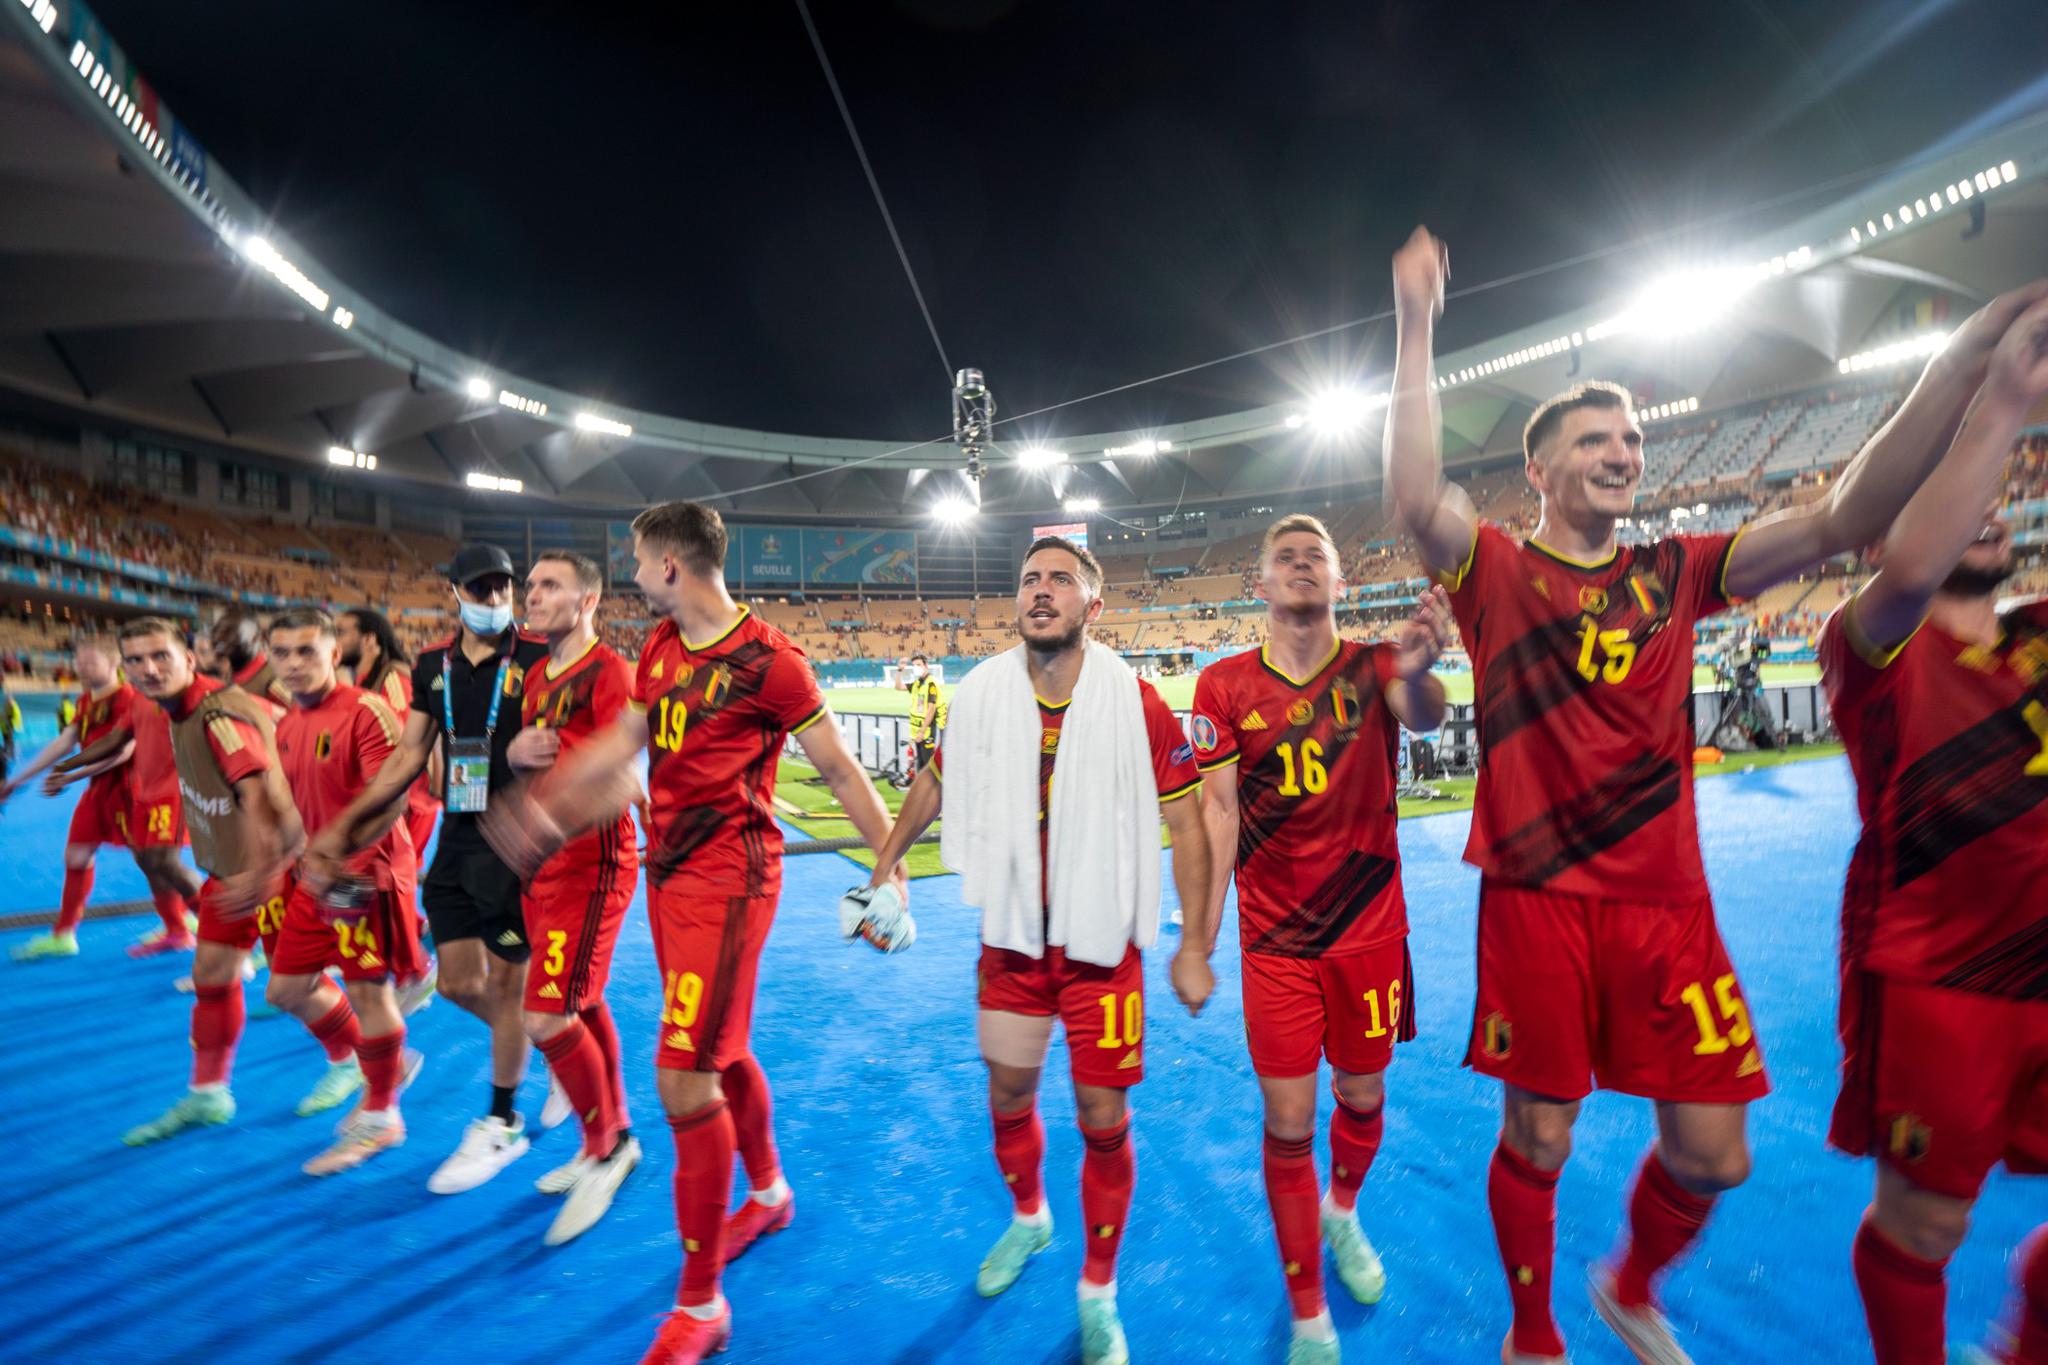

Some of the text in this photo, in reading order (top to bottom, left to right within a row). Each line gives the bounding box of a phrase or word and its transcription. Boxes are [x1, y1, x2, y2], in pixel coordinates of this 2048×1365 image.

[752, 564, 792, 576] SEVILLE
[1576, 614, 1637, 685] 15
[655, 696, 687, 753] 19
[1276, 737, 1328, 796] 16
[333, 916, 378, 958] 24
[543, 930, 567, 976] 3
[661, 968, 704, 1028] 19
[1096, 991, 1142, 1048] 10
[1363, 979, 1401, 1038] 16
[1681, 972, 1753, 1055] 15
